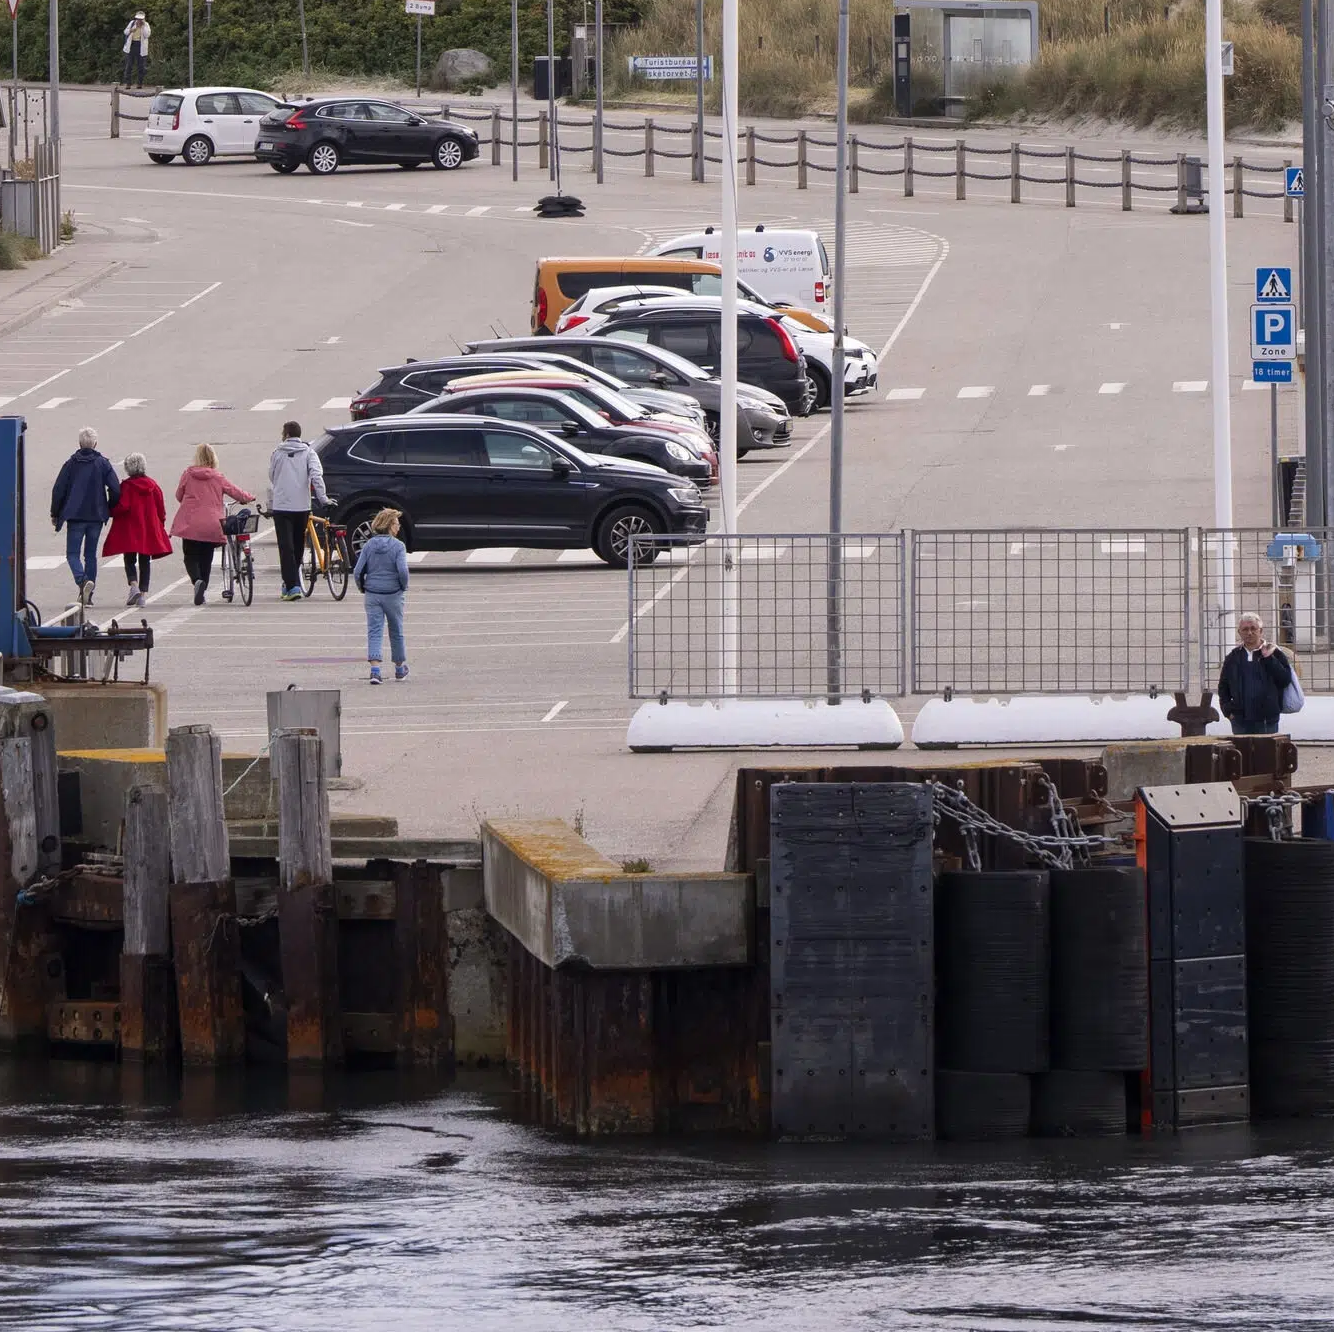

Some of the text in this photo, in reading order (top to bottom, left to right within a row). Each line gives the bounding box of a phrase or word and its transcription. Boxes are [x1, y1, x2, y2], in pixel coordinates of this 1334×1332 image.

[1264, 313, 1285, 342] P
[1261, 347, 1286, 356] Zone
[1254, 367, 1290, 376] 18 timer
